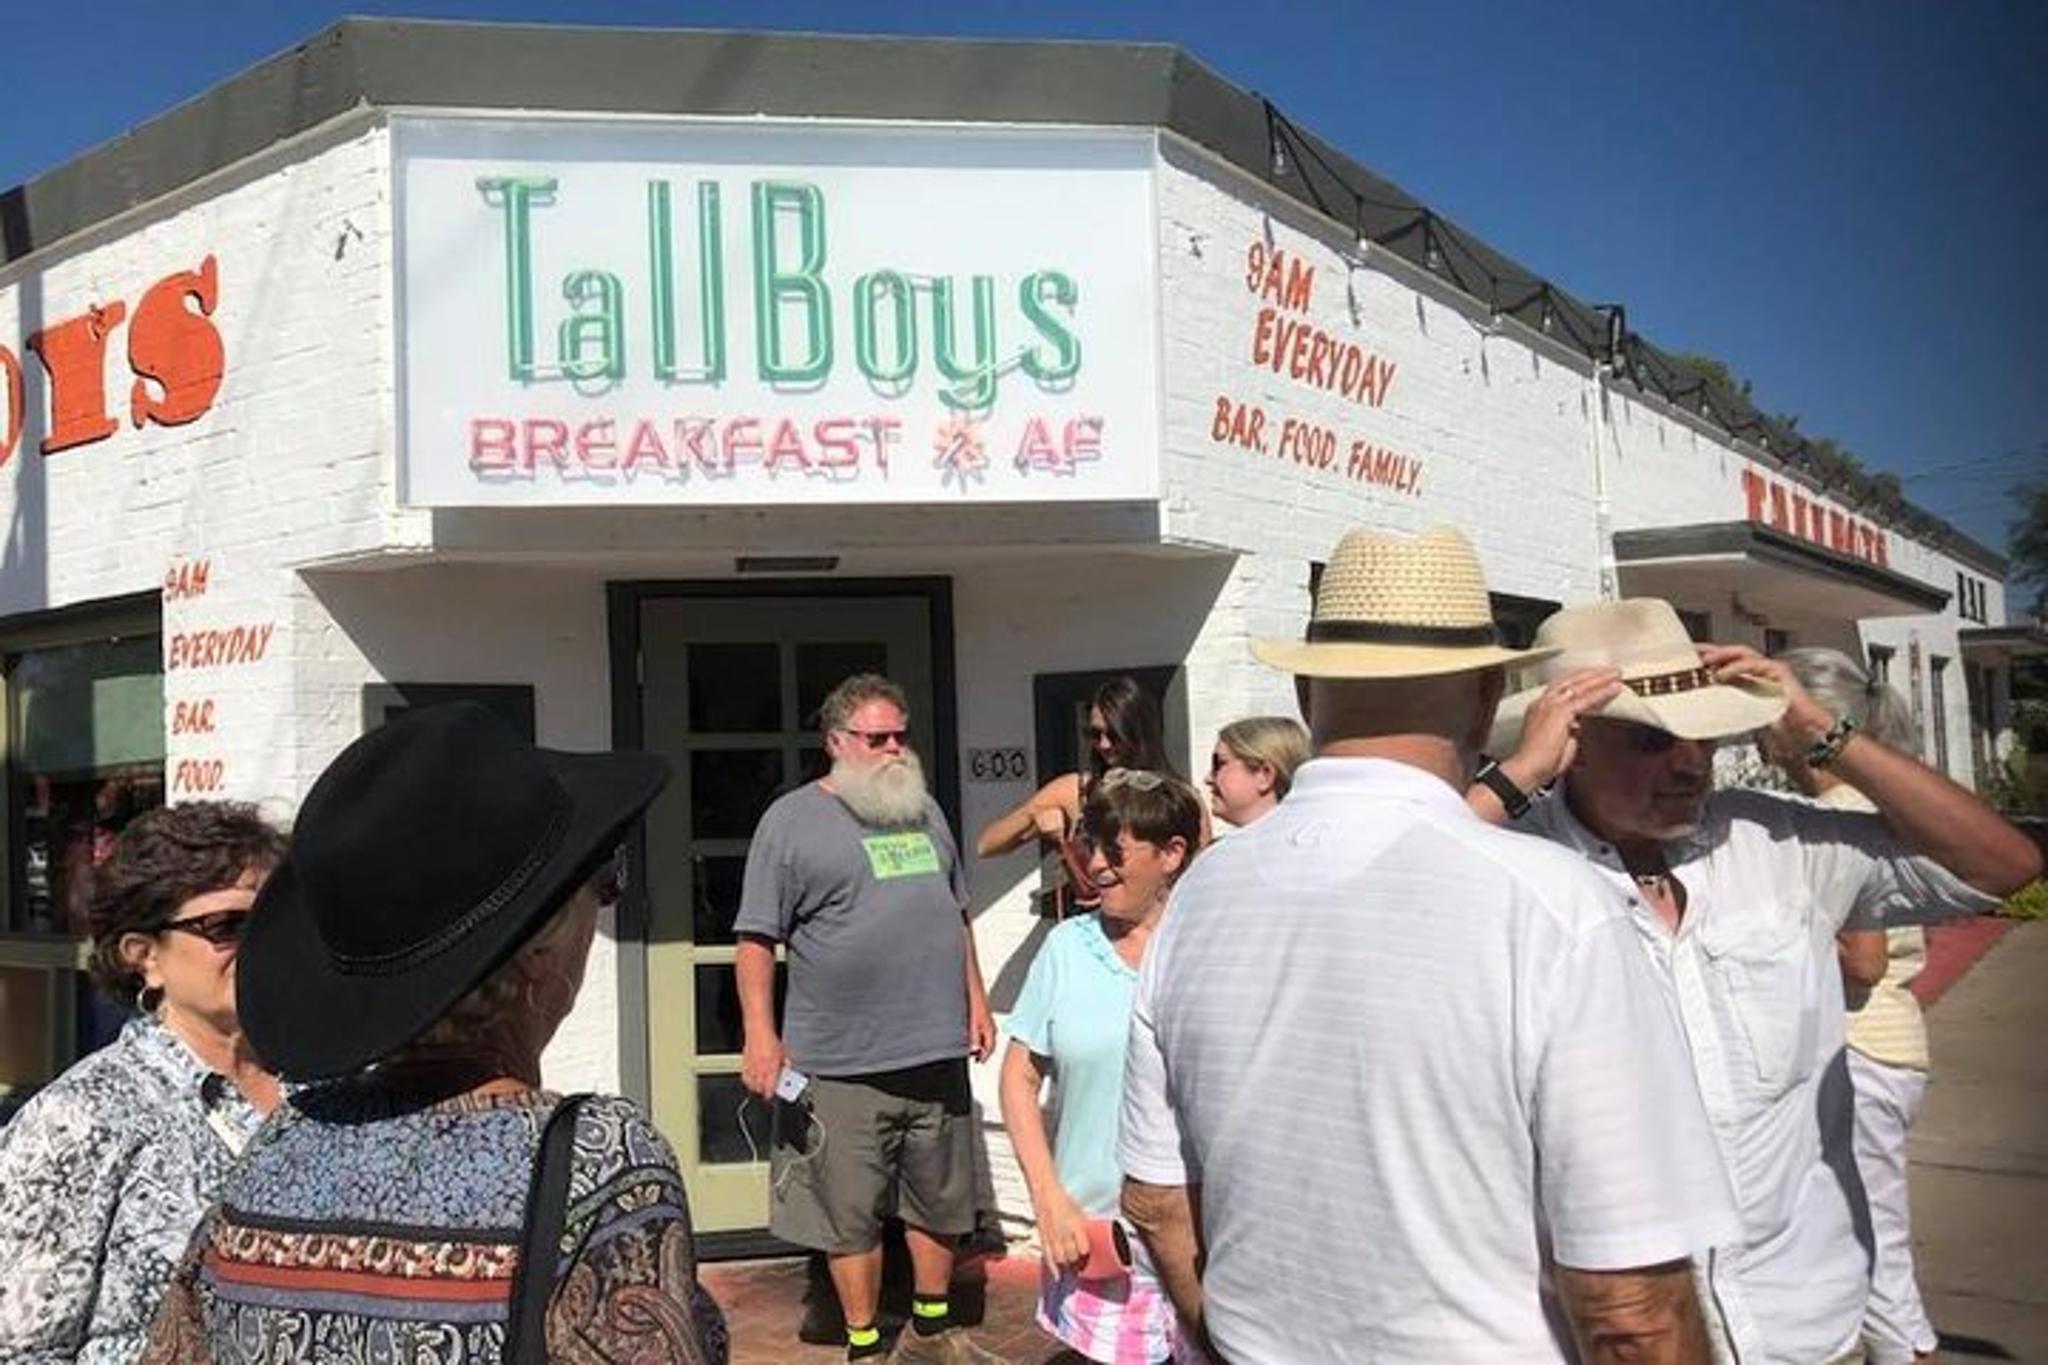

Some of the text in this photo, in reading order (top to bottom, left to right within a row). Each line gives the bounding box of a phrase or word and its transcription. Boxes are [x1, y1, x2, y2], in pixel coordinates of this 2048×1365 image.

[1246, 242, 1314, 314] 9AM
[1252, 309, 1396, 408] EVERYDAY
[469, 416, 901, 474] BREAKFAST
[1211, 396, 1423, 497] BAR. FOOD. FAMILY.
[165, 560, 210, 602] 9AM
[169, 621, 273, 670] EVERYDAY
[172, 758, 225, 792] FOOD.
[971, 751, 1027, 778] 600
